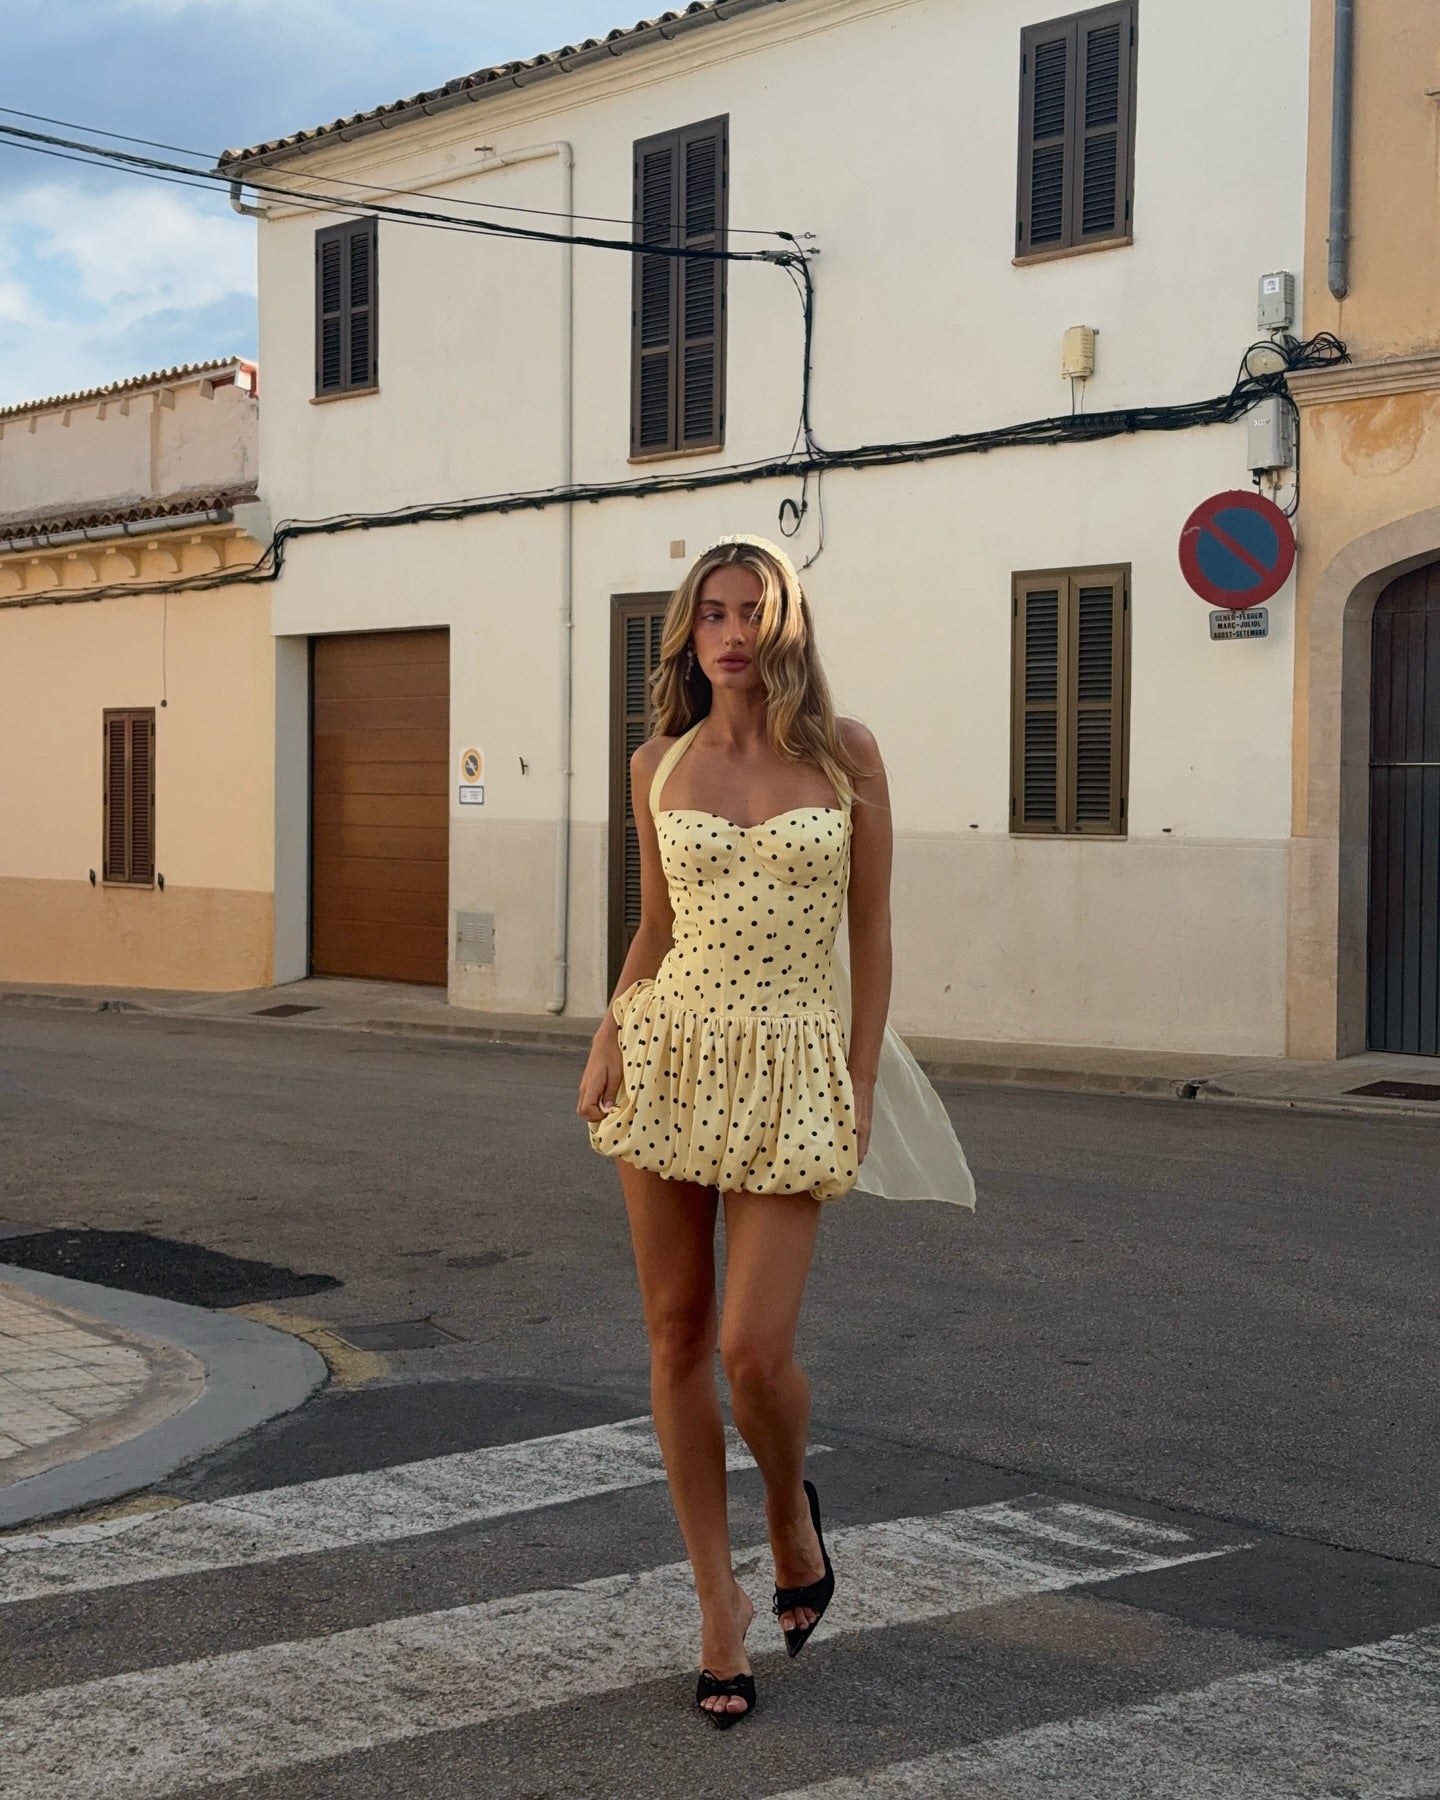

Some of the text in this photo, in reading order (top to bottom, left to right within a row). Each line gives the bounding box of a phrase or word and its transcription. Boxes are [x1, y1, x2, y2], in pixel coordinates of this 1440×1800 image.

[1215, 612, 1263, 622] GENER-FEBRER
[1217, 621, 1261, 630] MARÇ-JULIOL
[1213, 629, 1266, 639] AGOST-SETEMBRE
